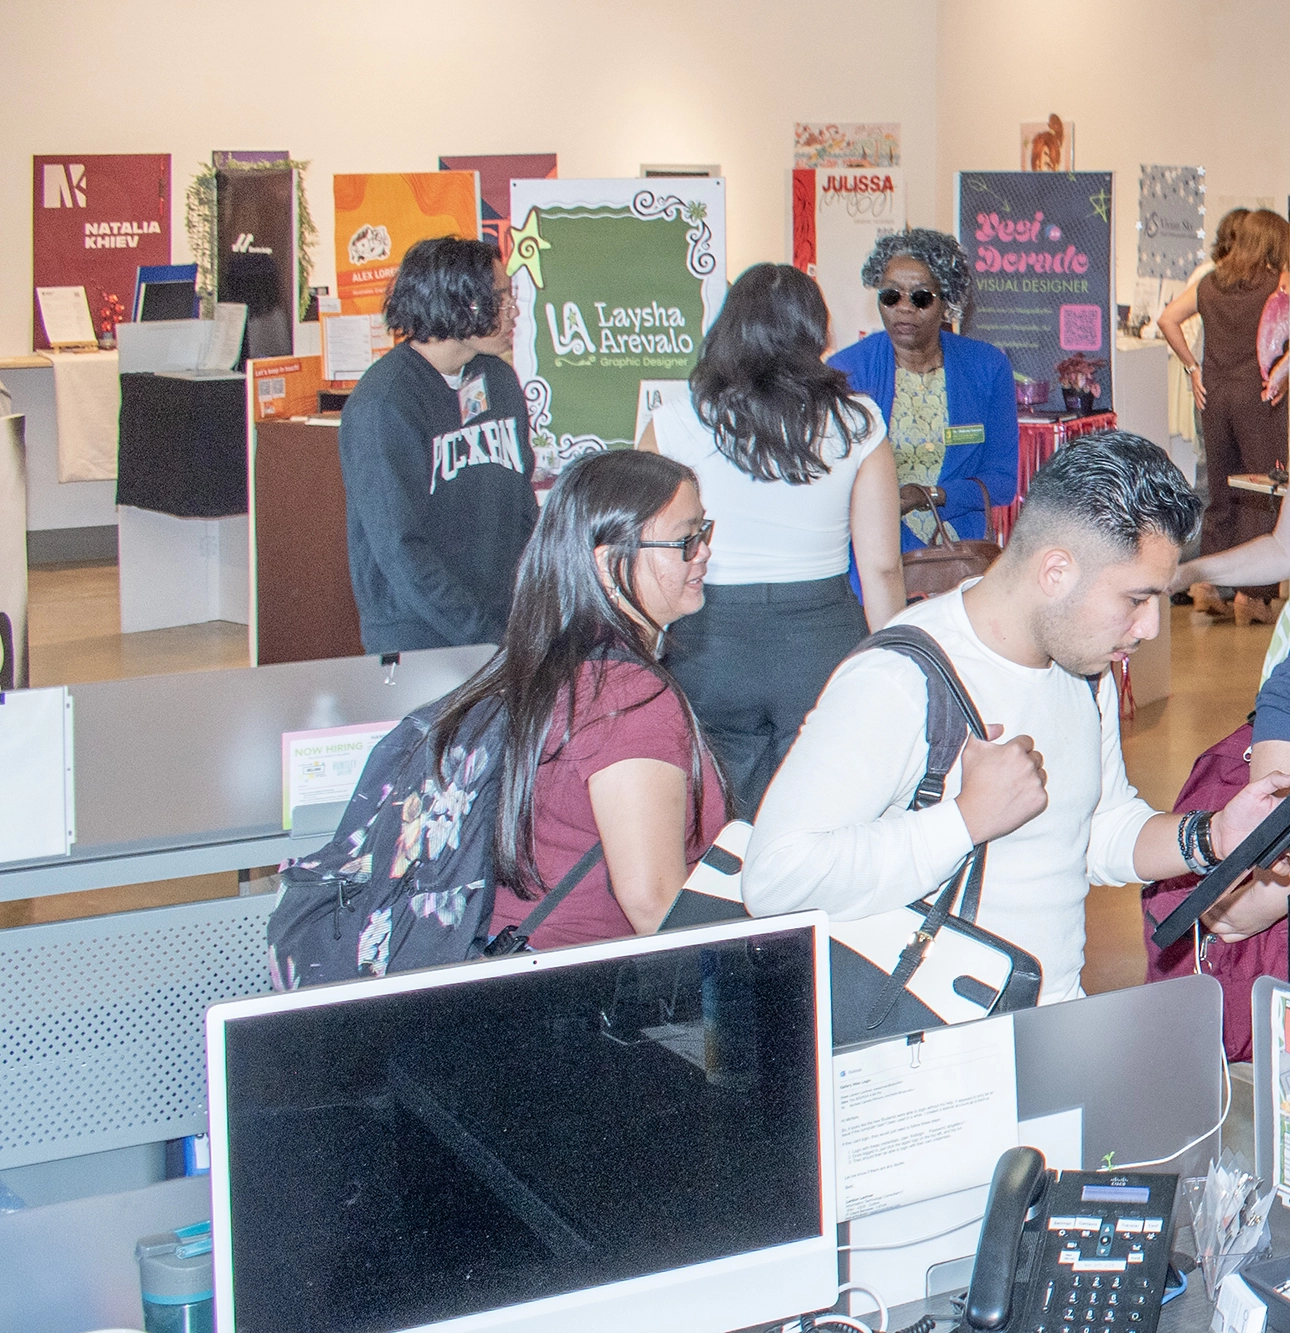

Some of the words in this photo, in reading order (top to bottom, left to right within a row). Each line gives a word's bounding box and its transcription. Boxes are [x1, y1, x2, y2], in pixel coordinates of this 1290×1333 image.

[822, 175, 894, 192] JULISSA
[84, 221, 161, 235] NATALIA
[84, 235, 140, 249] KHIEV
[975, 244, 1089, 274] Dorado
[352, 270, 373, 282] ALEX
[976, 279, 1018, 292] VISUAL
[1022, 279, 1088, 293] DESIGNER
[594, 300, 686, 333] Laysha
[600, 328, 694, 354] Arevalo
[600, 357, 640, 368] Graphic
[643, 357, 688, 368] Designer
[294, 746, 322, 757] NOW
[326, 742, 364, 754] HIRING
